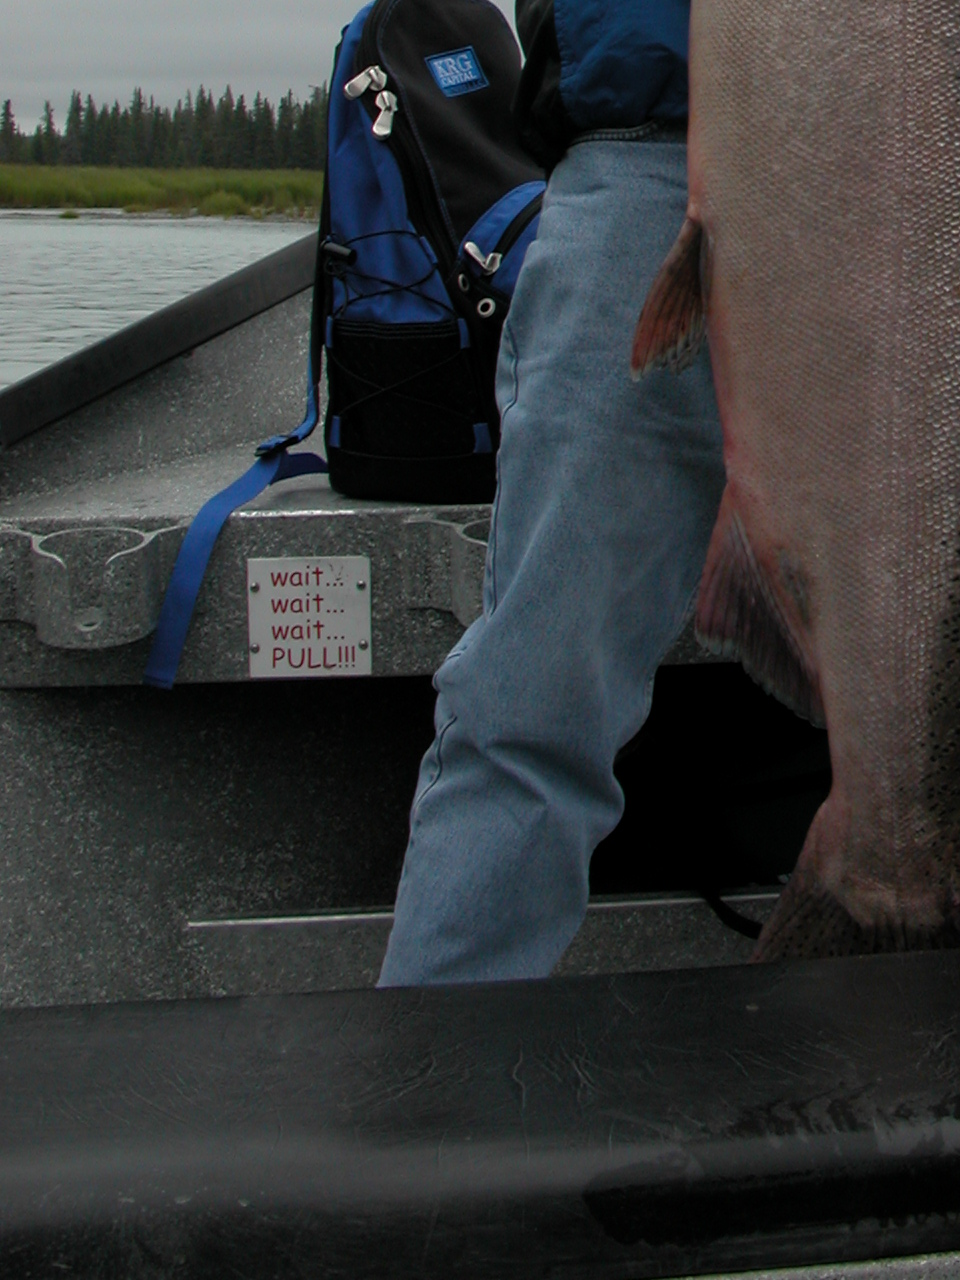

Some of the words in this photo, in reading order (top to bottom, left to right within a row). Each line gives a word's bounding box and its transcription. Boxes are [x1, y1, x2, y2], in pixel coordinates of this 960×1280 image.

[433, 54, 473, 77] KRG
[441, 71, 477, 86] CAPITAL
[270, 565, 344, 587] wait...
[271, 593, 345, 614] wait...
[271, 619, 345, 640] wait...
[272, 645, 356, 669] PULL!!!
